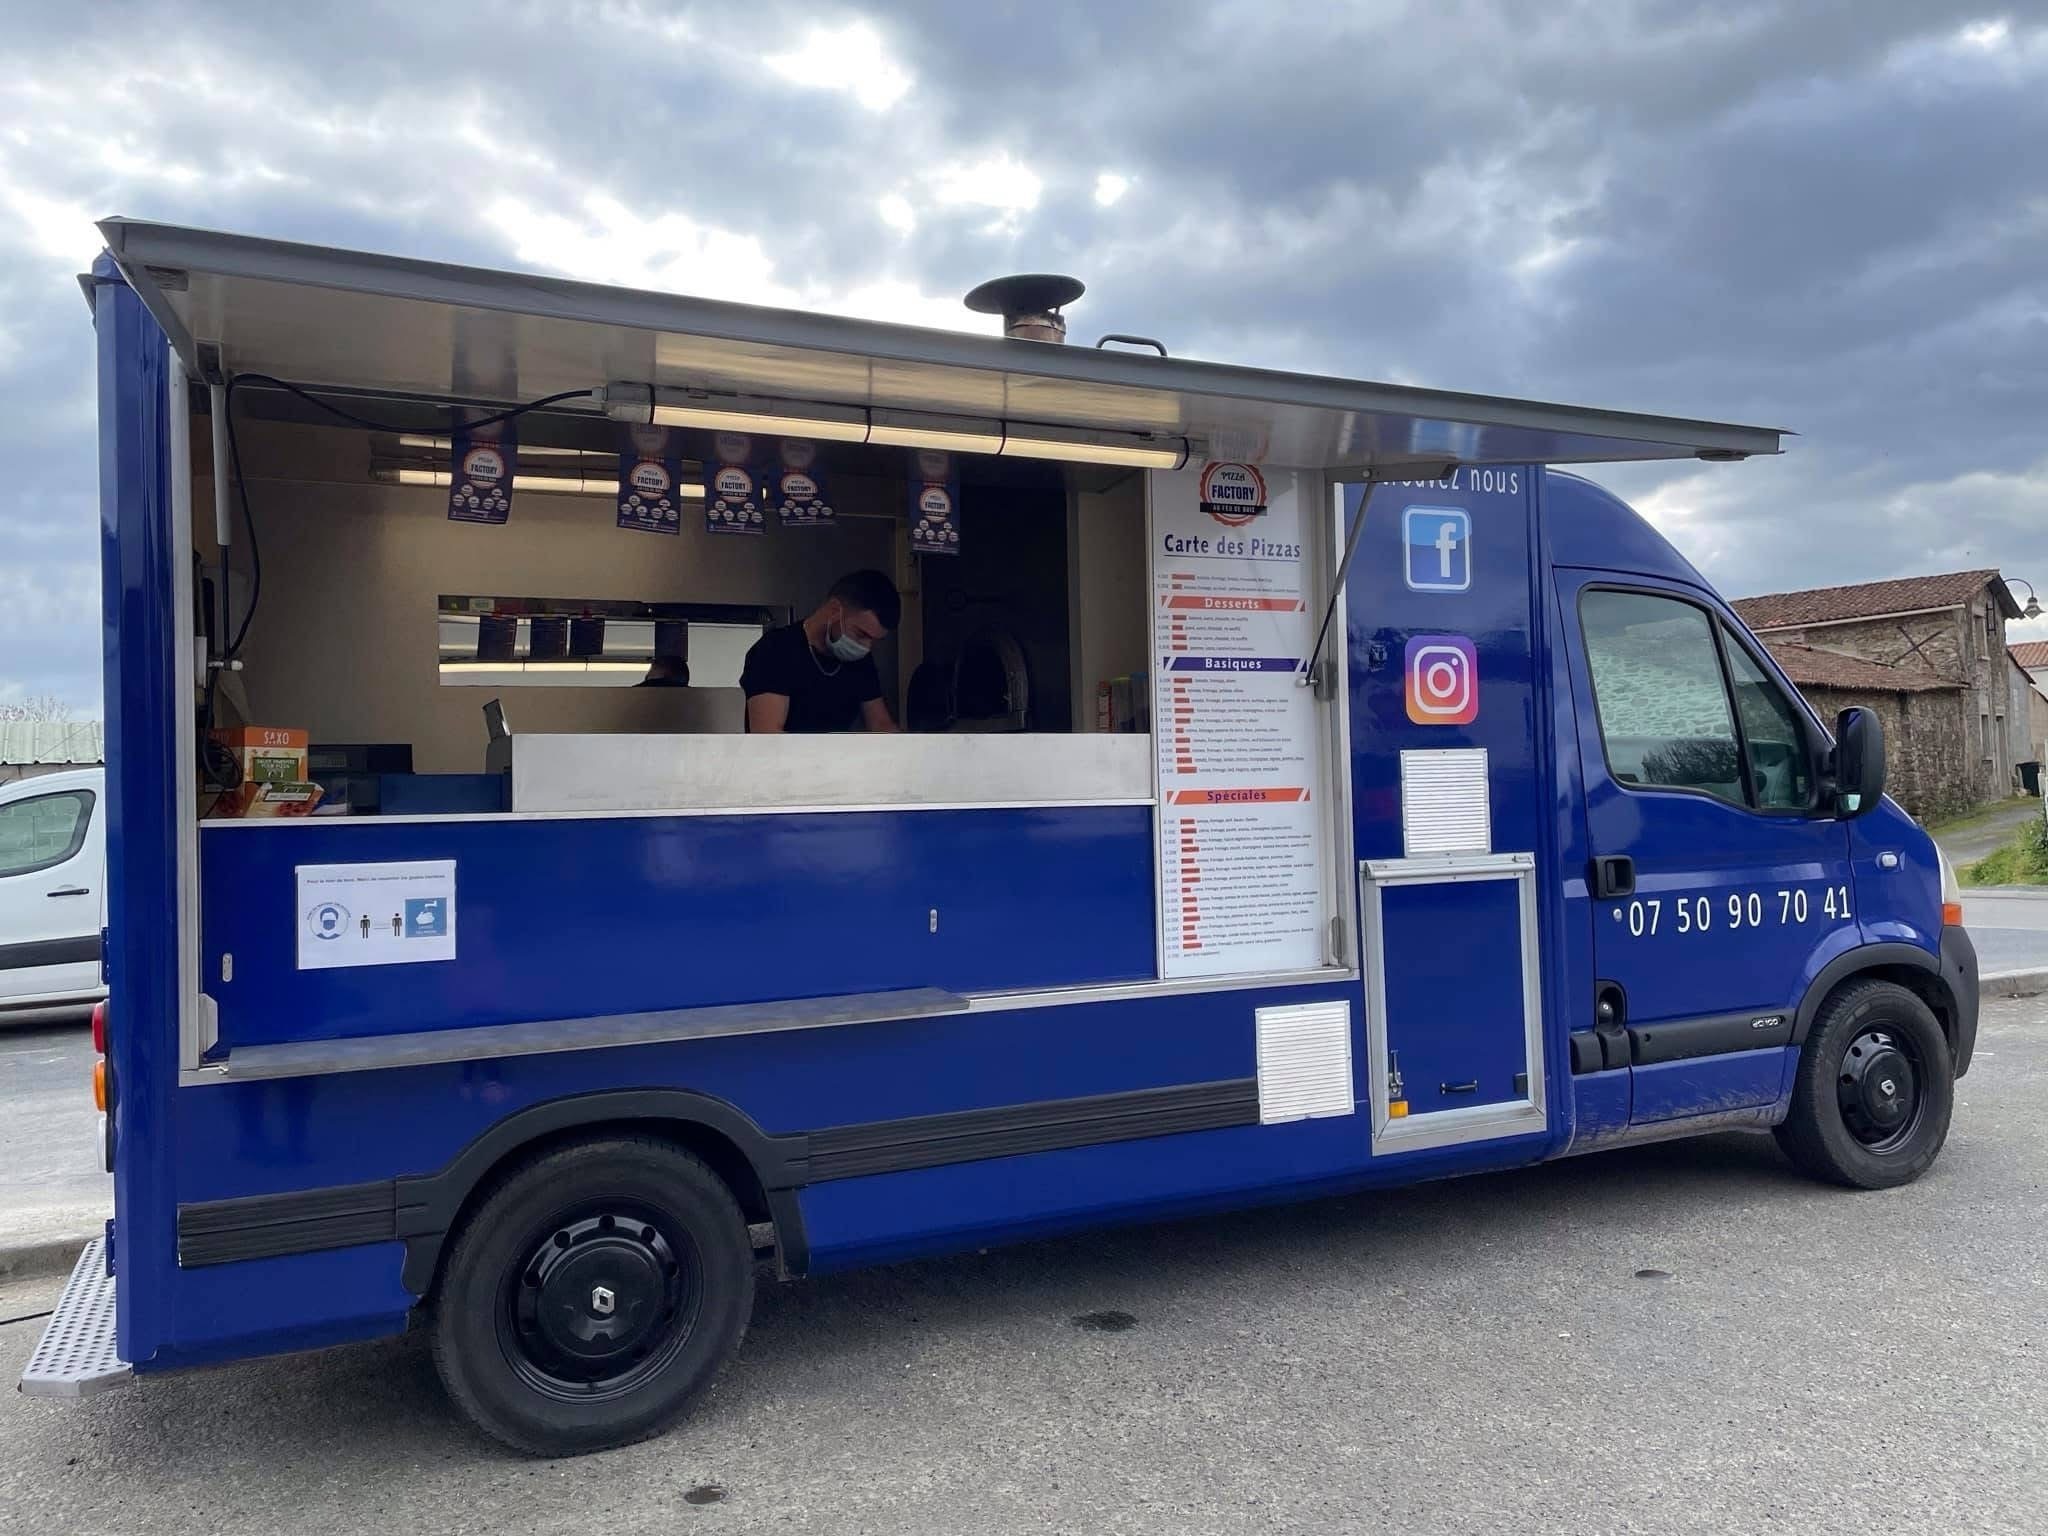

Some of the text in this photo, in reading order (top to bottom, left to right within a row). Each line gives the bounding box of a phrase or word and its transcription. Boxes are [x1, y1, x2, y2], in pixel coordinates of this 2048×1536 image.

[1221, 471, 1246, 482] PIZZA
[1470, 468, 1519, 495] nous
[1212, 485, 1255, 501] FACTORY
[1164, 534, 1301, 558] Carte des Pizzas
[1204, 598, 1260, 610] Desserts
[1205, 659, 1262, 672] Basiques
[263, 730, 290, 745] SAXO
[1207, 789, 1267, 803] Spéciales
[1628, 885, 1852, 938] 07 50 90 70 41
